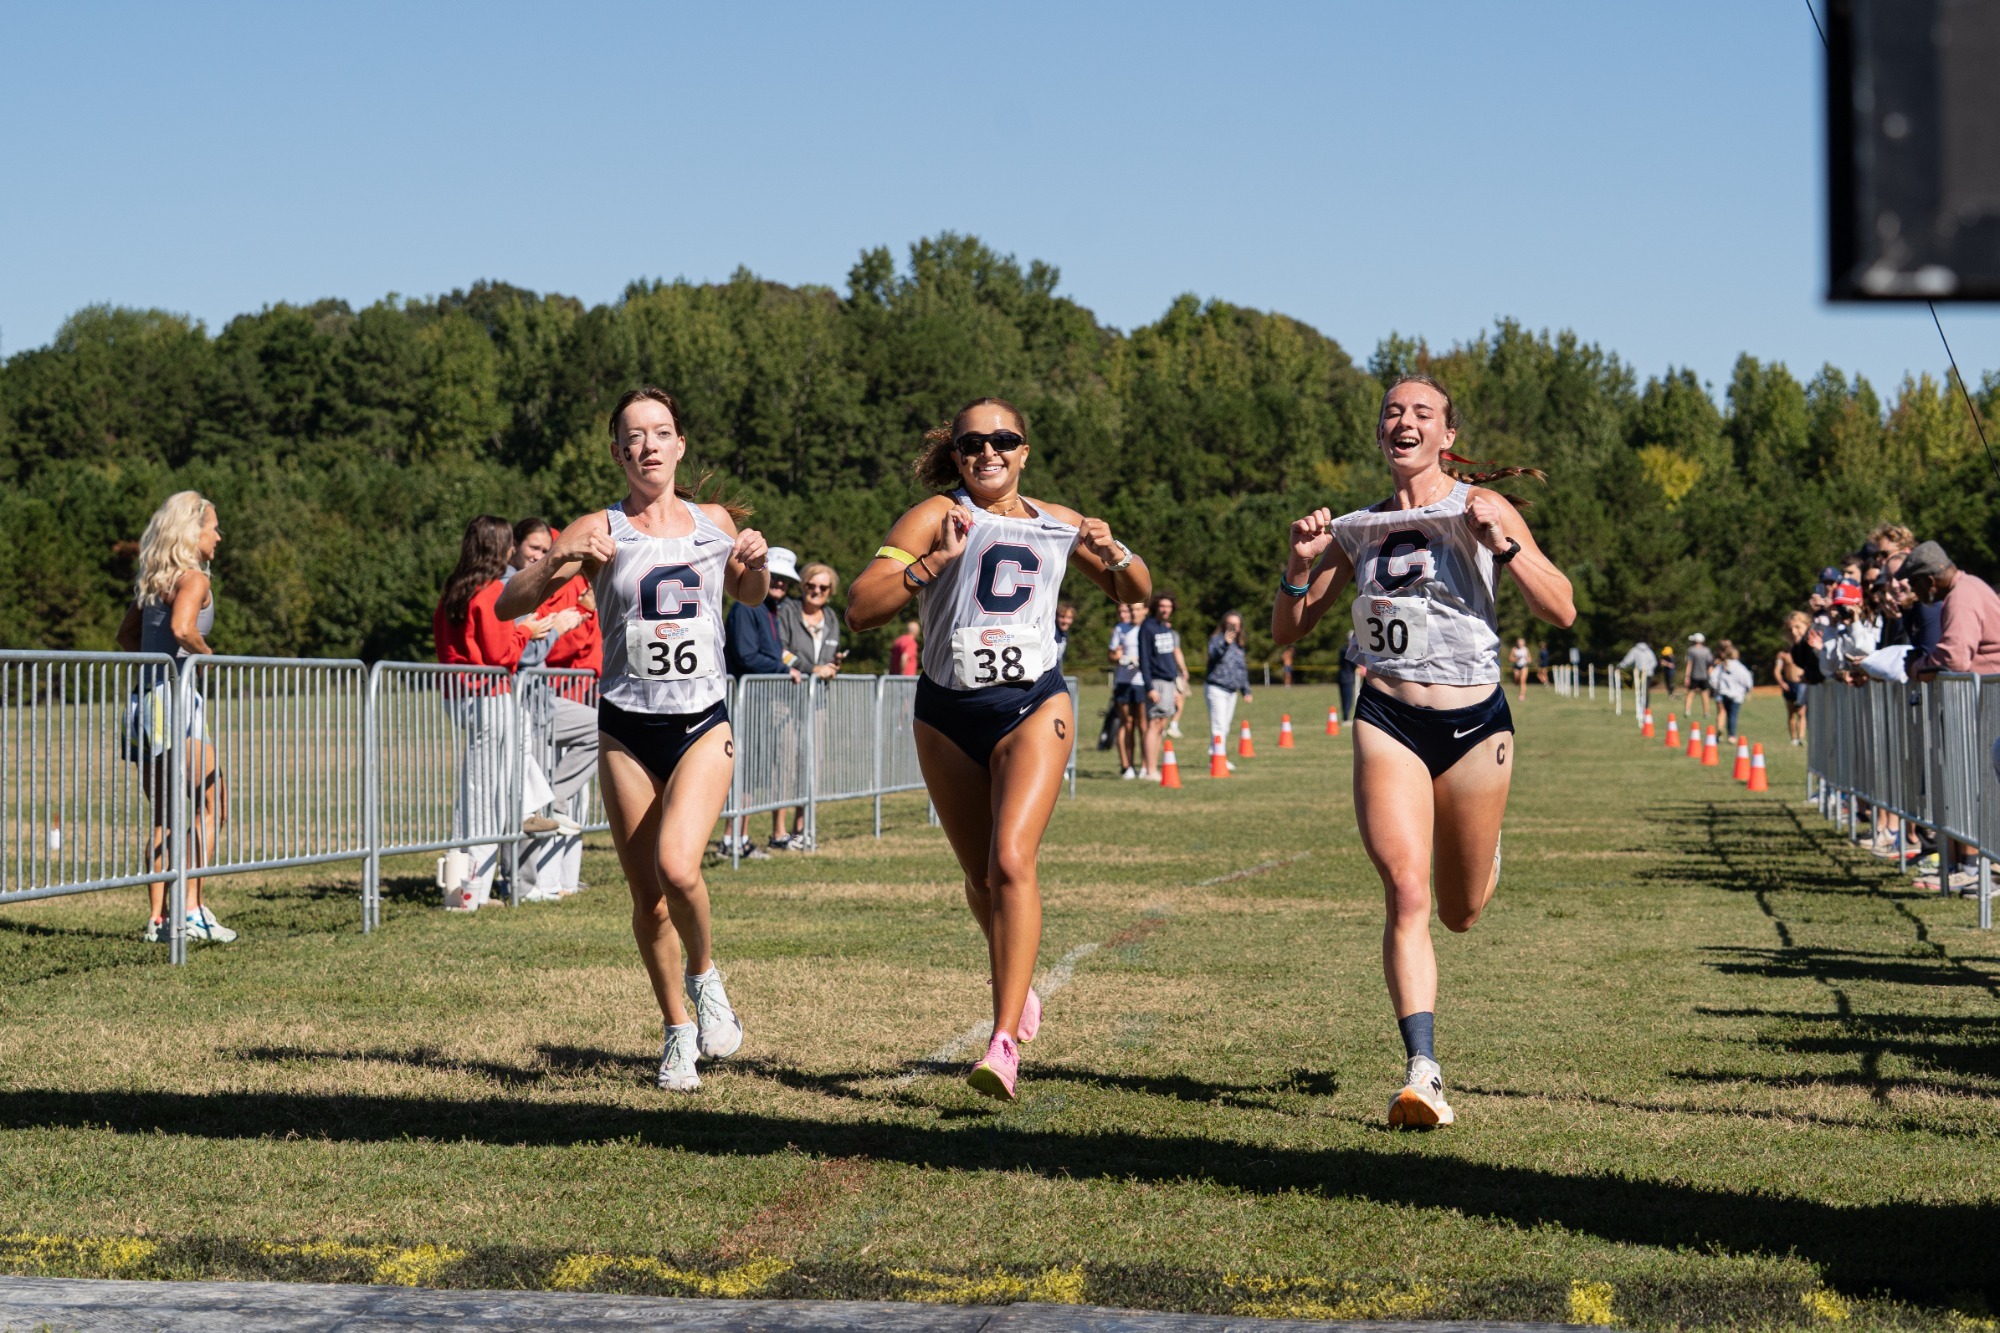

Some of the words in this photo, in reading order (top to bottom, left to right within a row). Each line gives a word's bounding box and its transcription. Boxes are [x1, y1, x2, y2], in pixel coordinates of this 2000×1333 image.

[974, 541, 1043, 615] C
[1374, 529, 1432, 594] C
[638, 563, 702, 620] C
[1367, 618, 1408, 654] 30
[647, 640, 697, 675] 36
[974, 646, 1024, 683] 38
[1054, 718, 1065, 740] C
[724, 740, 734, 758] C
[1496, 743, 1505, 765] C
